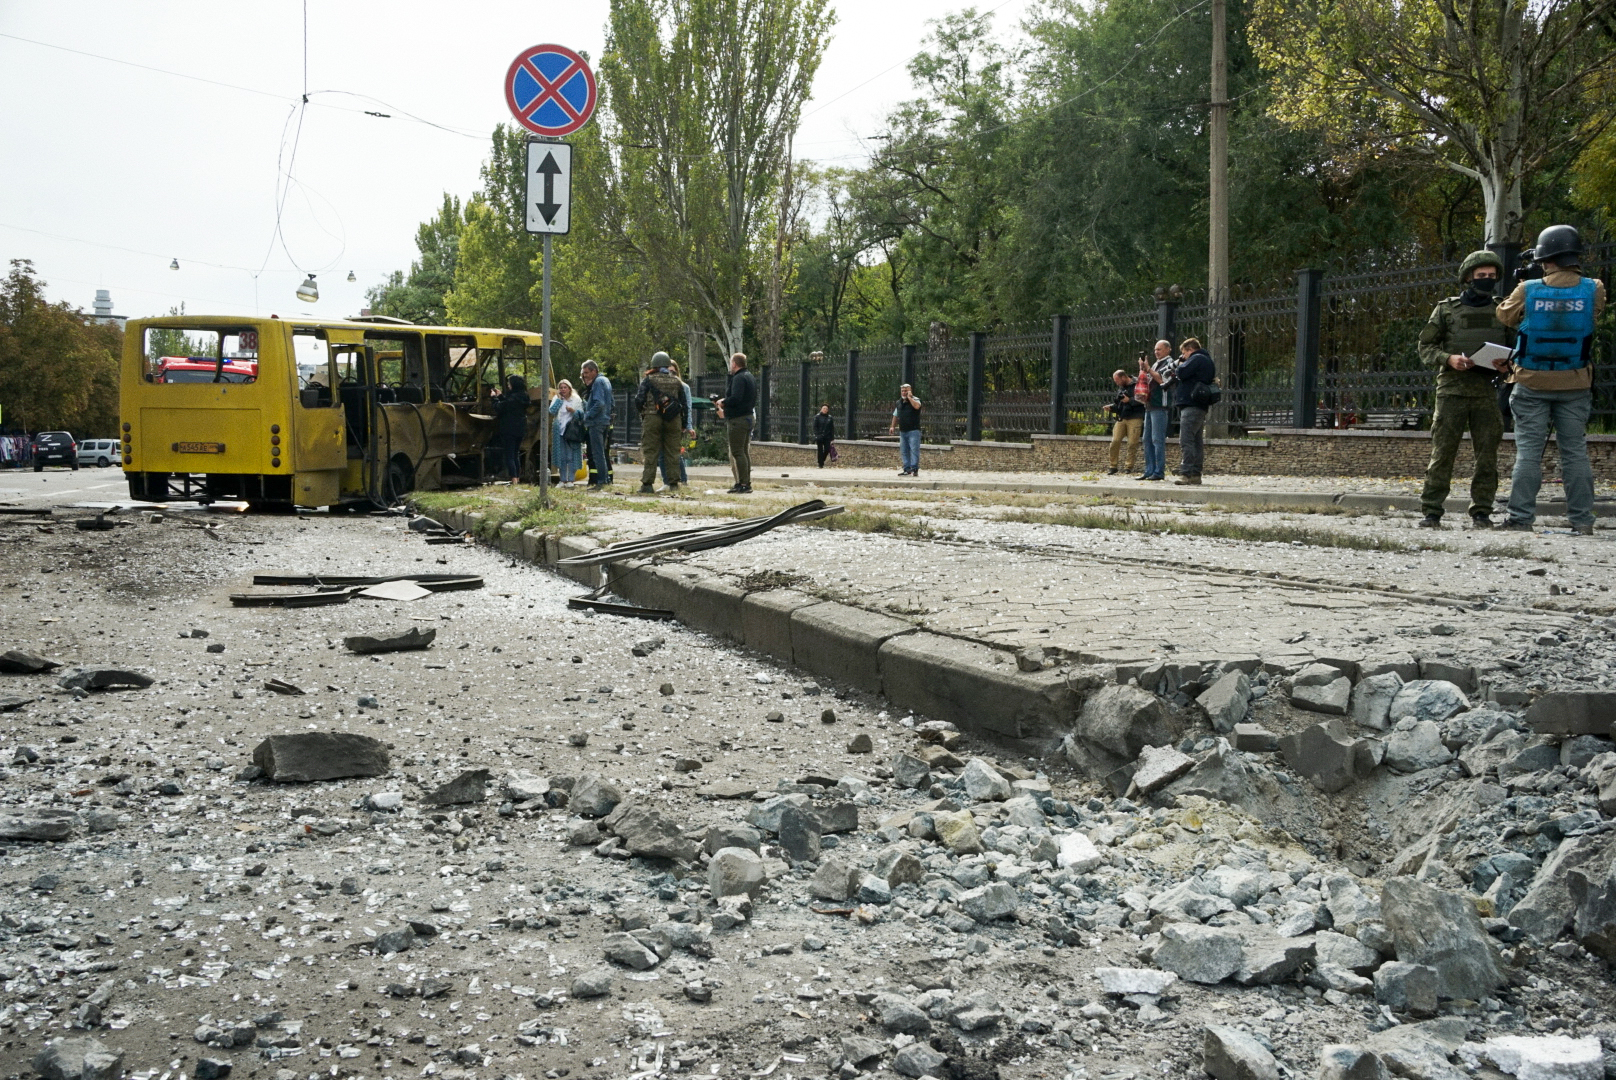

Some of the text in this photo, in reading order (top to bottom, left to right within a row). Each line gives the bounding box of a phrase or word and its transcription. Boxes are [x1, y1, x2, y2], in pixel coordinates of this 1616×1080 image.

[1534, 300, 1584, 311] PRESS
[239, 332, 257, 350] 38
[40, 434, 53, 442] Z
